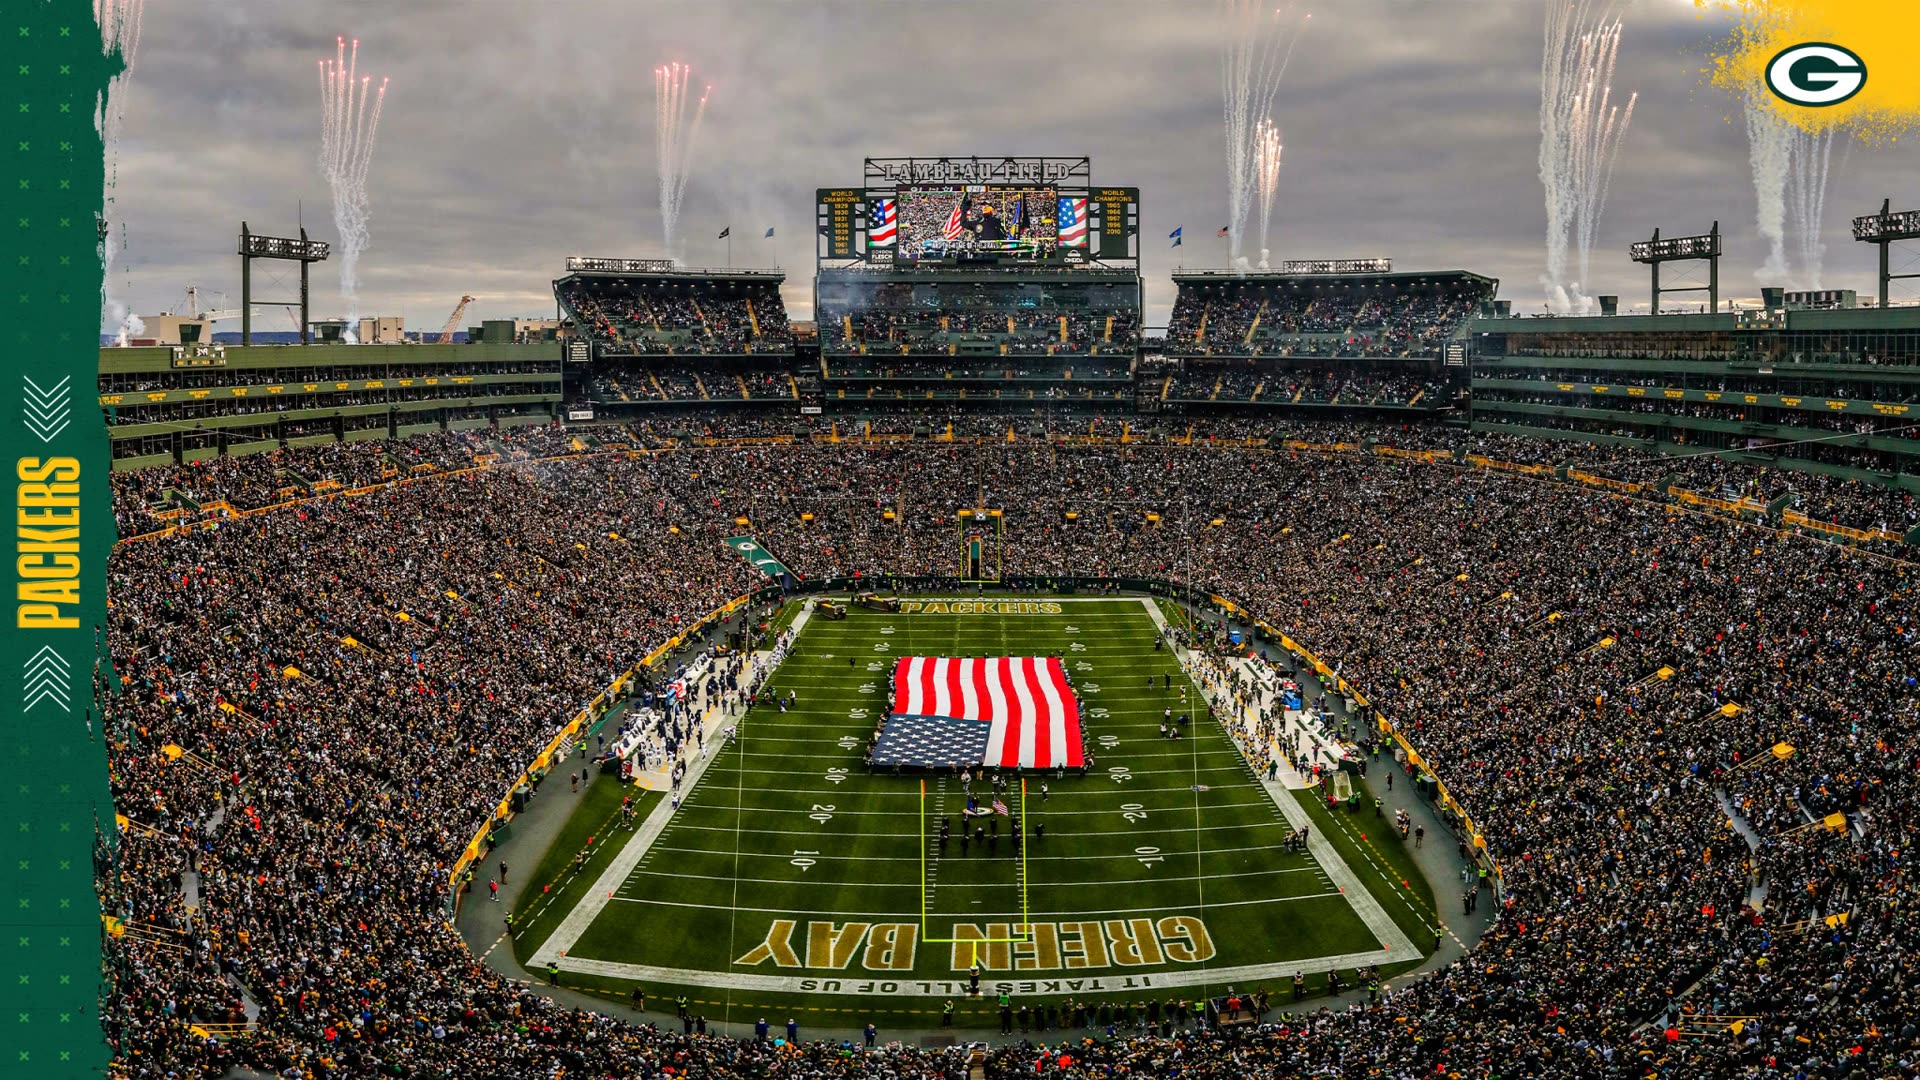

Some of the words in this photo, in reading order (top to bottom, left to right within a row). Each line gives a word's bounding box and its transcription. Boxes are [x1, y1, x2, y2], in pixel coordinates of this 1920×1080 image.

[884, 163, 992, 181] LAMBEAU
[1003, 163, 1071, 180] FIELD
[899, 601, 1062, 614] PACKERS
[848, 708, 869, 719] 50
[1089, 707, 1110, 718] 50
[837, 735, 859, 747] 40
[1098, 735, 1120, 747] 40
[824, 767, 849, 781] 30
[1108, 766, 1132, 780] 30
[809, 804, 836, 821] 20
[1120, 803, 1147, 819] 20
[790, 850, 820, 866] 10
[1134, 846, 1164, 862] 10
[733, 919, 919, 971] BAY
[950, 916, 1217, 971] GREEN
[800, 980, 841, 992] US
[858, 982, 898, 993] OF
[995, 979, 1105, 994] TAKES
[1122, 976, 1150, 988] IT
